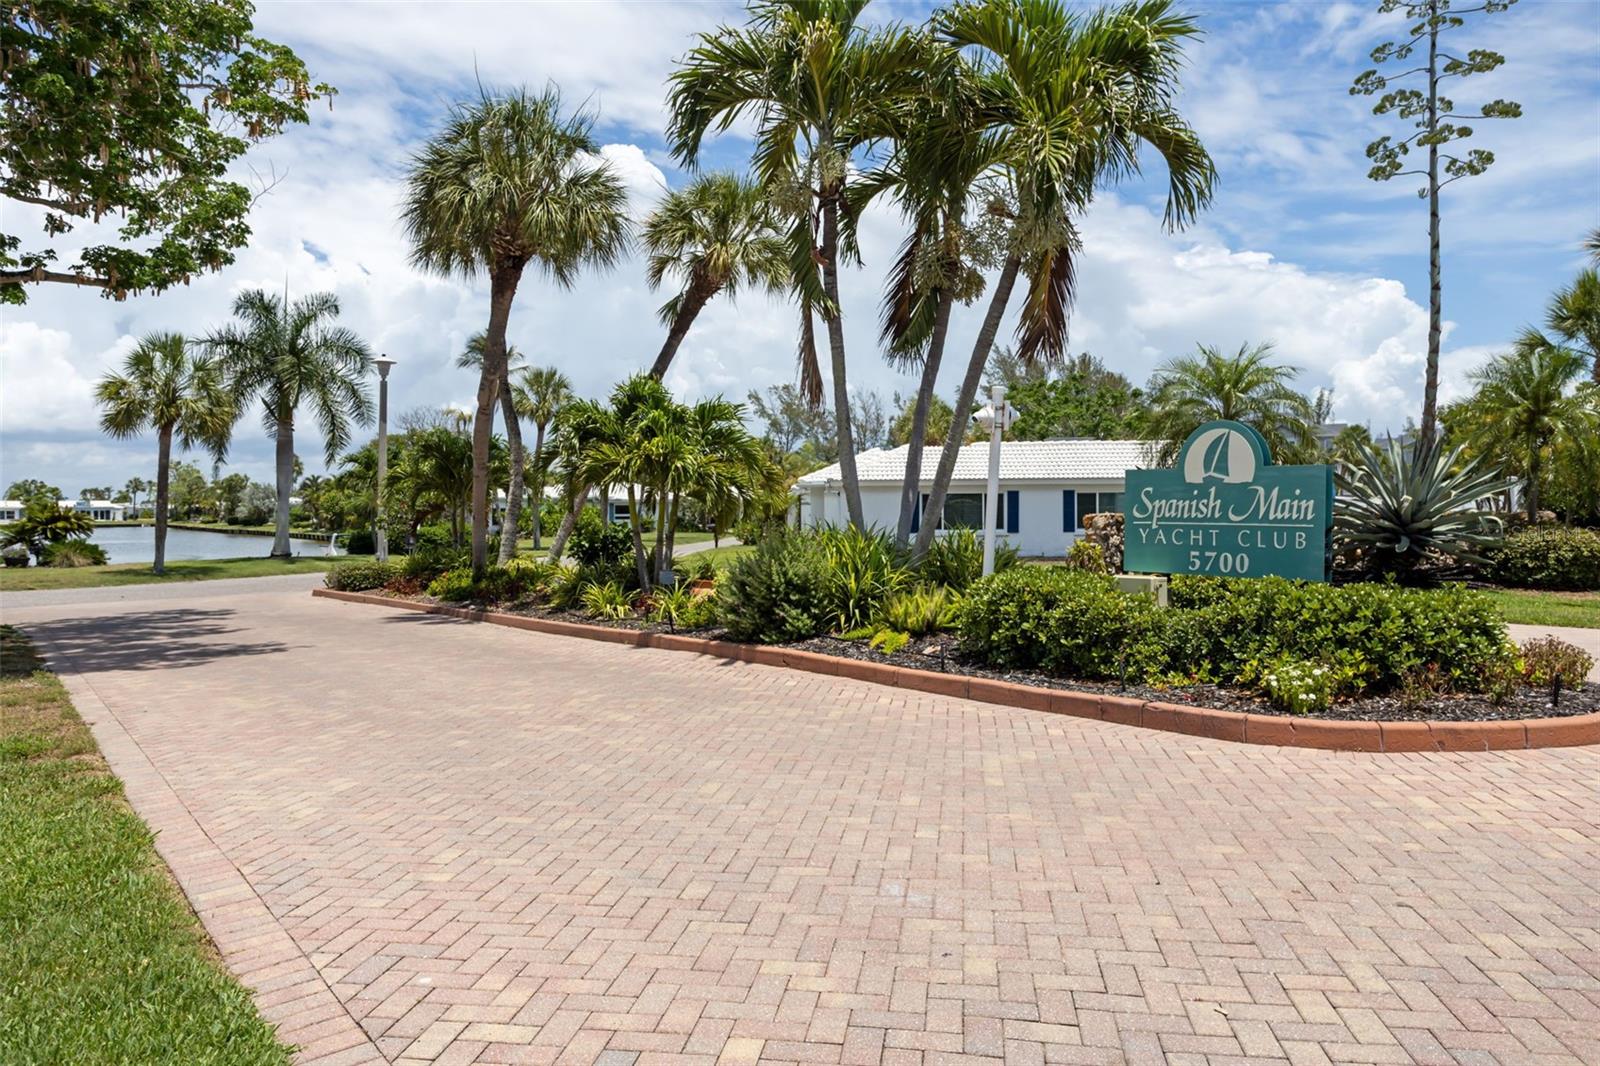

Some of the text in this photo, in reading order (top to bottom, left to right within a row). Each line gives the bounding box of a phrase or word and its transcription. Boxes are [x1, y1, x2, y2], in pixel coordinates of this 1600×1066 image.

[1133, 486, 1315, 528] Spanish Main
[1139, 528, 1307, 549] YACHT CLUB
[1188, 551, 1250, 574] 5700
